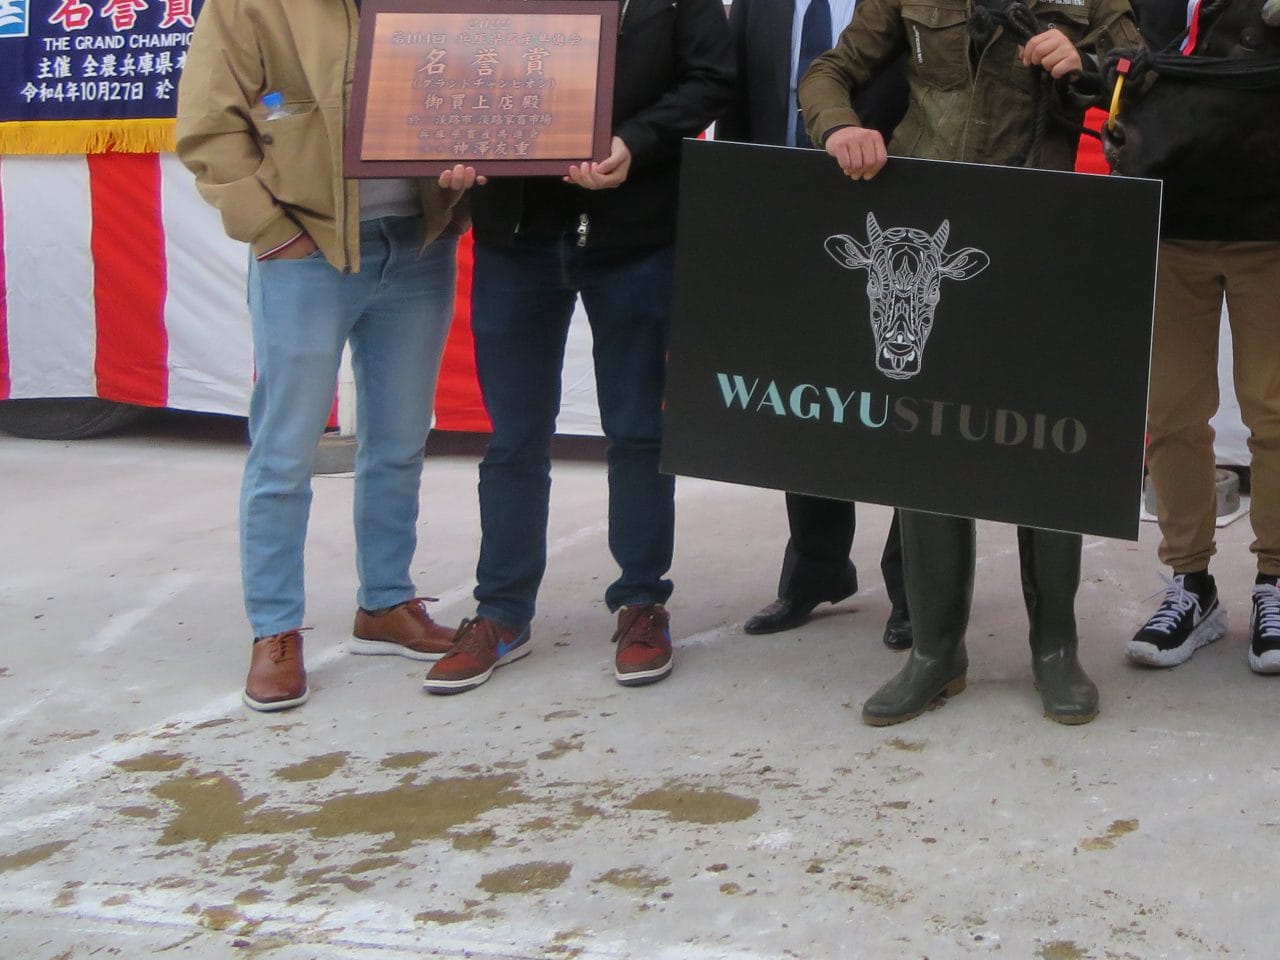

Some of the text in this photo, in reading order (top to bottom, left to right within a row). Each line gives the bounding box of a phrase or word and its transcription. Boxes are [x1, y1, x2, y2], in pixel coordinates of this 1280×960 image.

[44, 37, 71, 51] THE
[75, 35, 125, 50] GRAND
[37, 55, 72, 79] 主催
[418, 48, 550, 76] 名誉賞
[20, 81, 174, 102] 令和4年10月27日 於
